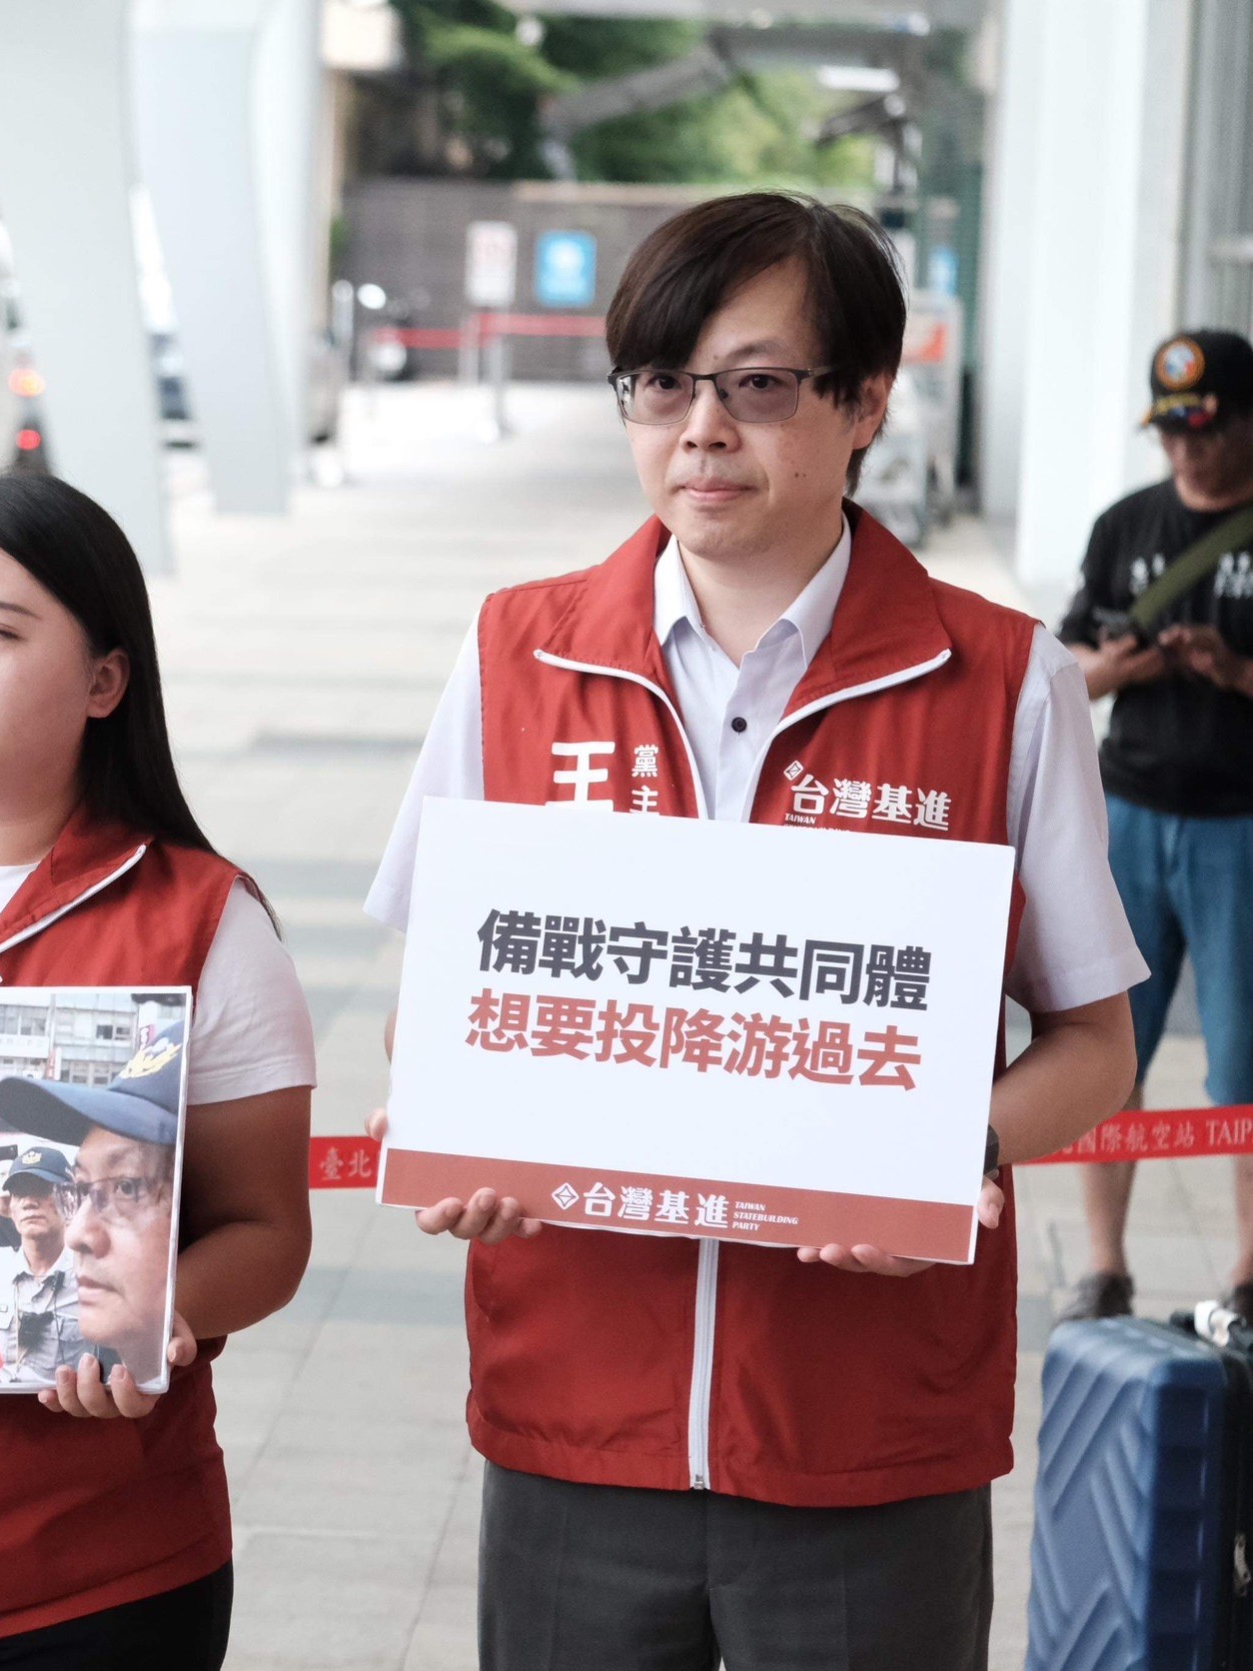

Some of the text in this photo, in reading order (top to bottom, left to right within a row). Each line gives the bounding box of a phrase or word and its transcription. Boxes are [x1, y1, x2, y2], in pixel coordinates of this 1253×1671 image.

[546, 741, 616, 812] 王
[785, 813, 816, 825] TAIWAN
[790, 773, 952, 832] 台灣基進
[477, 908, 932, 1011] 備戰守護共同體
[465, 988, 922, 1092] 想要投降游過去
[1062, 1118, 1253, 1155] 國際航空站 TAIP
[320, 1146, 372, 1180] 臺北
[583, 1181, 730, 1229] 台灣基進
[733, 1211, 799, 1225] STATEBUILDING
[735, 1201, 766, 1211] TAIWAN
[732, 1220, 761, 1231] PARTY
